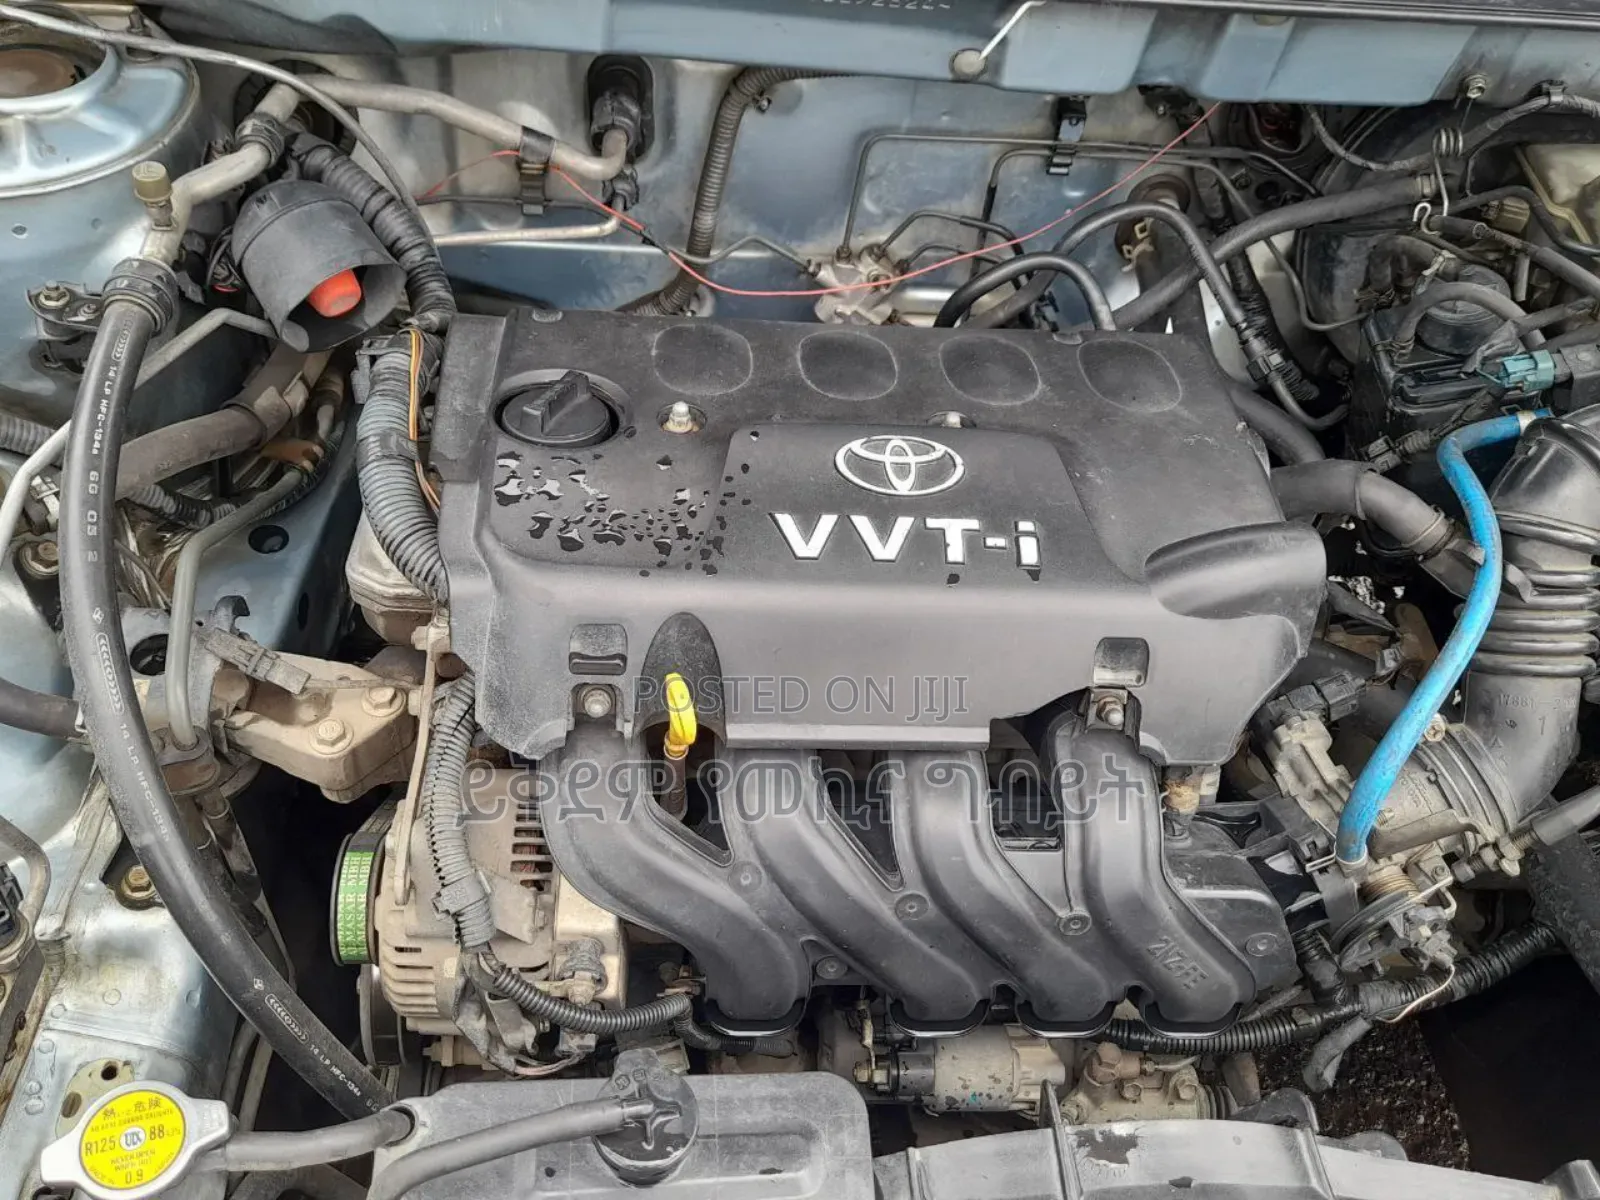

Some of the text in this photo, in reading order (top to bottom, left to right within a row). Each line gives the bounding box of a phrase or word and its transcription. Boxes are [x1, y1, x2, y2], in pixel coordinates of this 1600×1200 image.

[767, 512, 1042, 569] VVT-i
[84, 1136, 116, 1157] R125
[148, 1123, 165, 1141] 88
